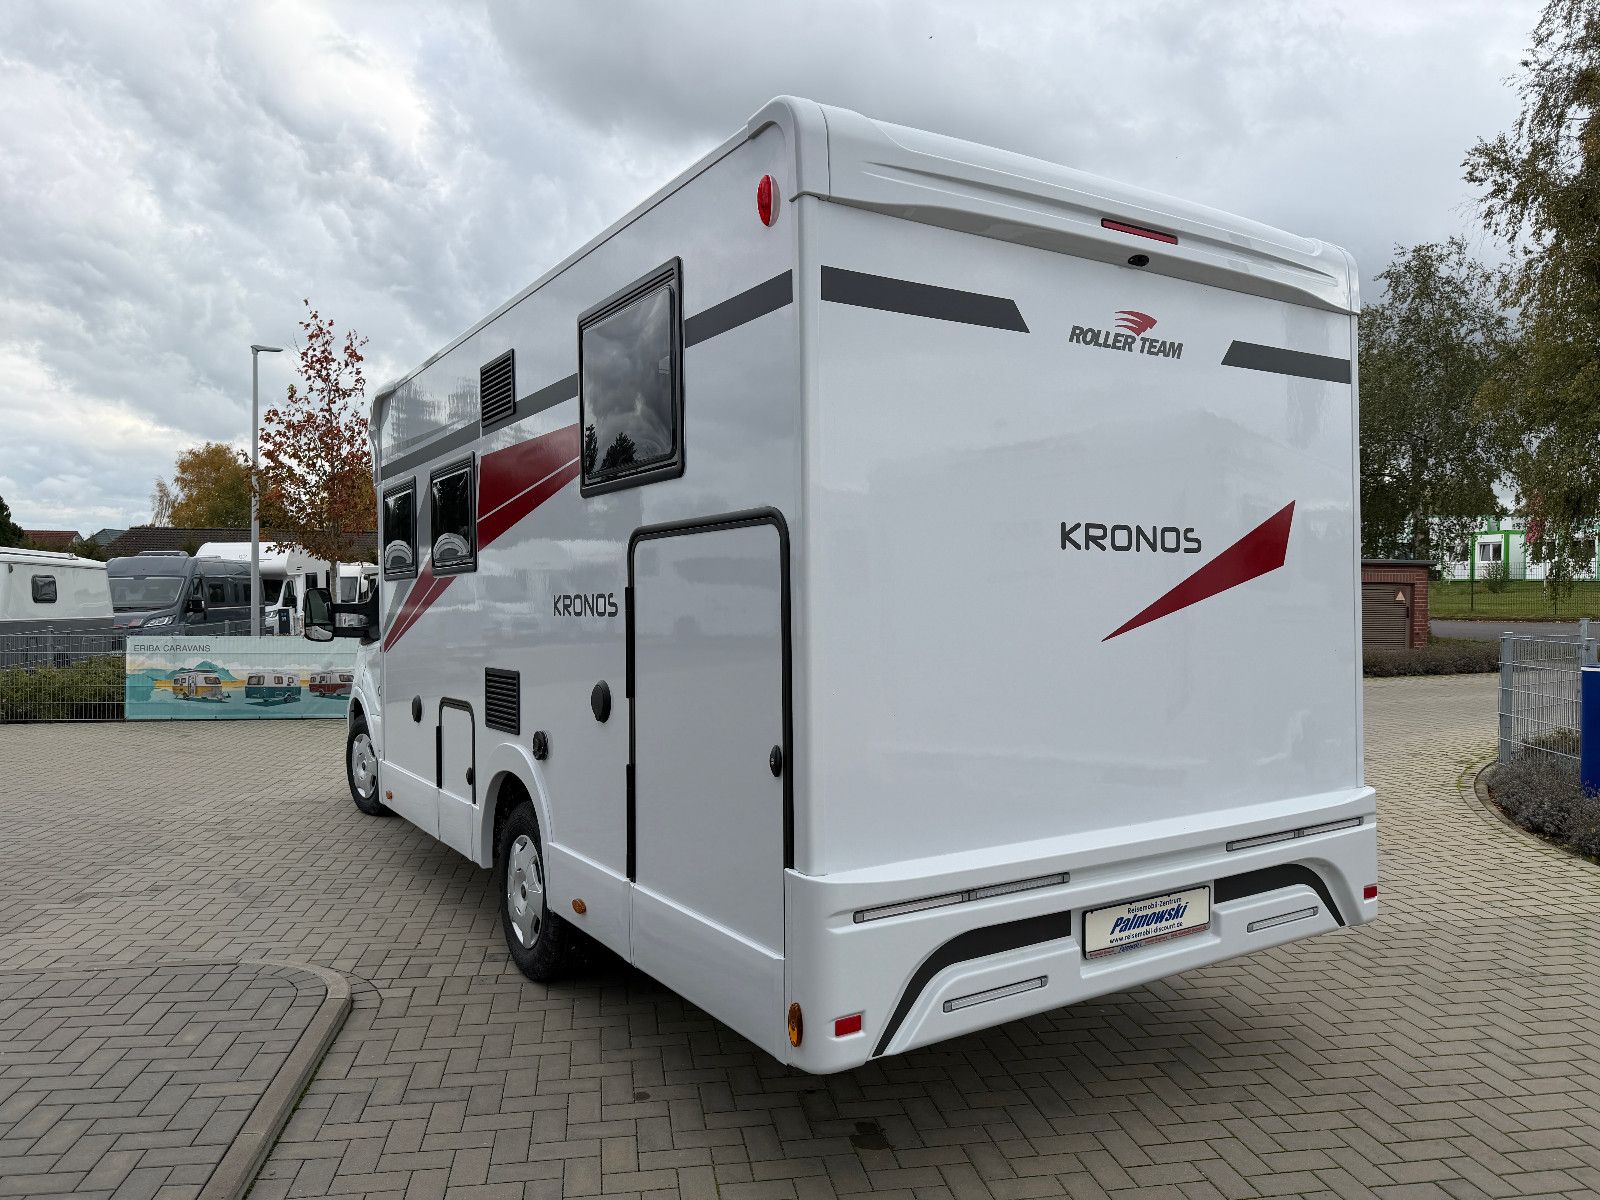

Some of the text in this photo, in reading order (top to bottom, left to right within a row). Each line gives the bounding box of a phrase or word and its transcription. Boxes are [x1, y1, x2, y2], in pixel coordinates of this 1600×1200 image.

[1069, 325, 1183, 359] ROLLER TEAM
[1061, 522, 1201, 553] KRONOS
[554, 593, 618, 617] KRONOS
[1110, 902, 1189, 935] Palmowski
[1127, 897, 1182, 914] Reisemobil-Zentrum
